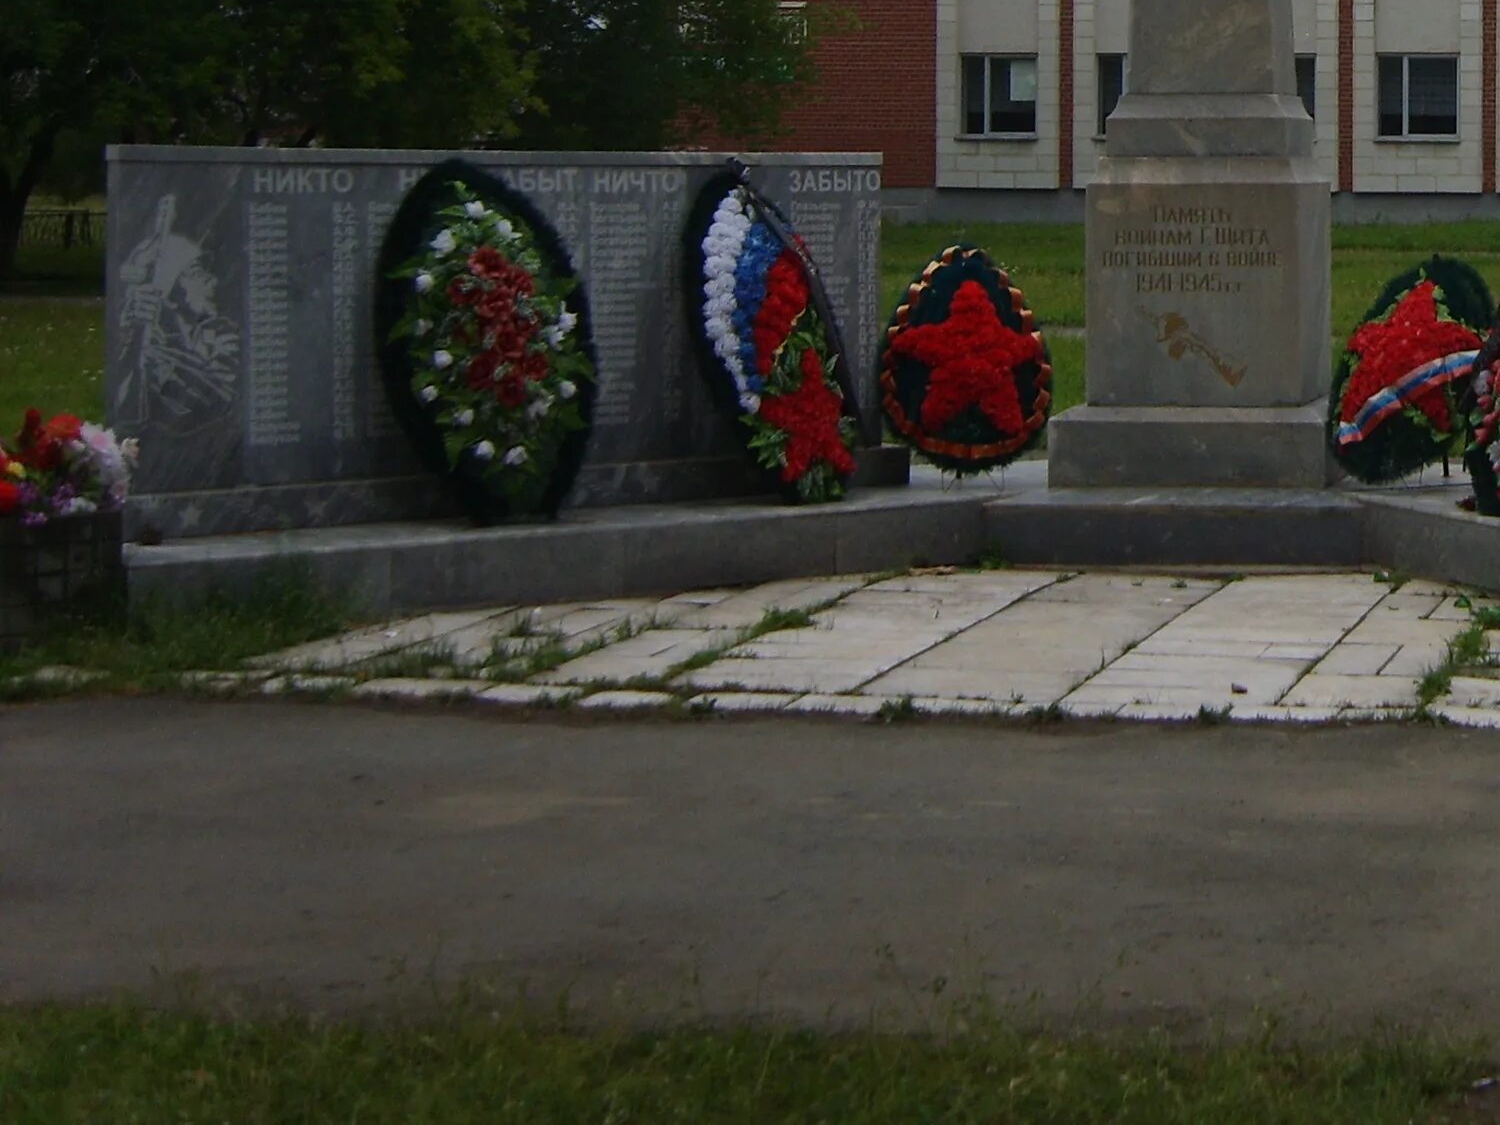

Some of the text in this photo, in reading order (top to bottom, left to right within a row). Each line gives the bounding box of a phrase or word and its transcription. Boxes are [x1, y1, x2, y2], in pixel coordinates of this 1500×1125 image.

[253, 168, 353, 193] НИКТО
[501, 169, 578, 193] АБЫТ
[593, 171, 679, 193] НИЧТО
[789, 170, 881, 192] ЗАБЫТО
[1114, 229, 1192, 246] ВОИНАМ
[1102, 250, 1202, 268] ПОГИБШИМ
